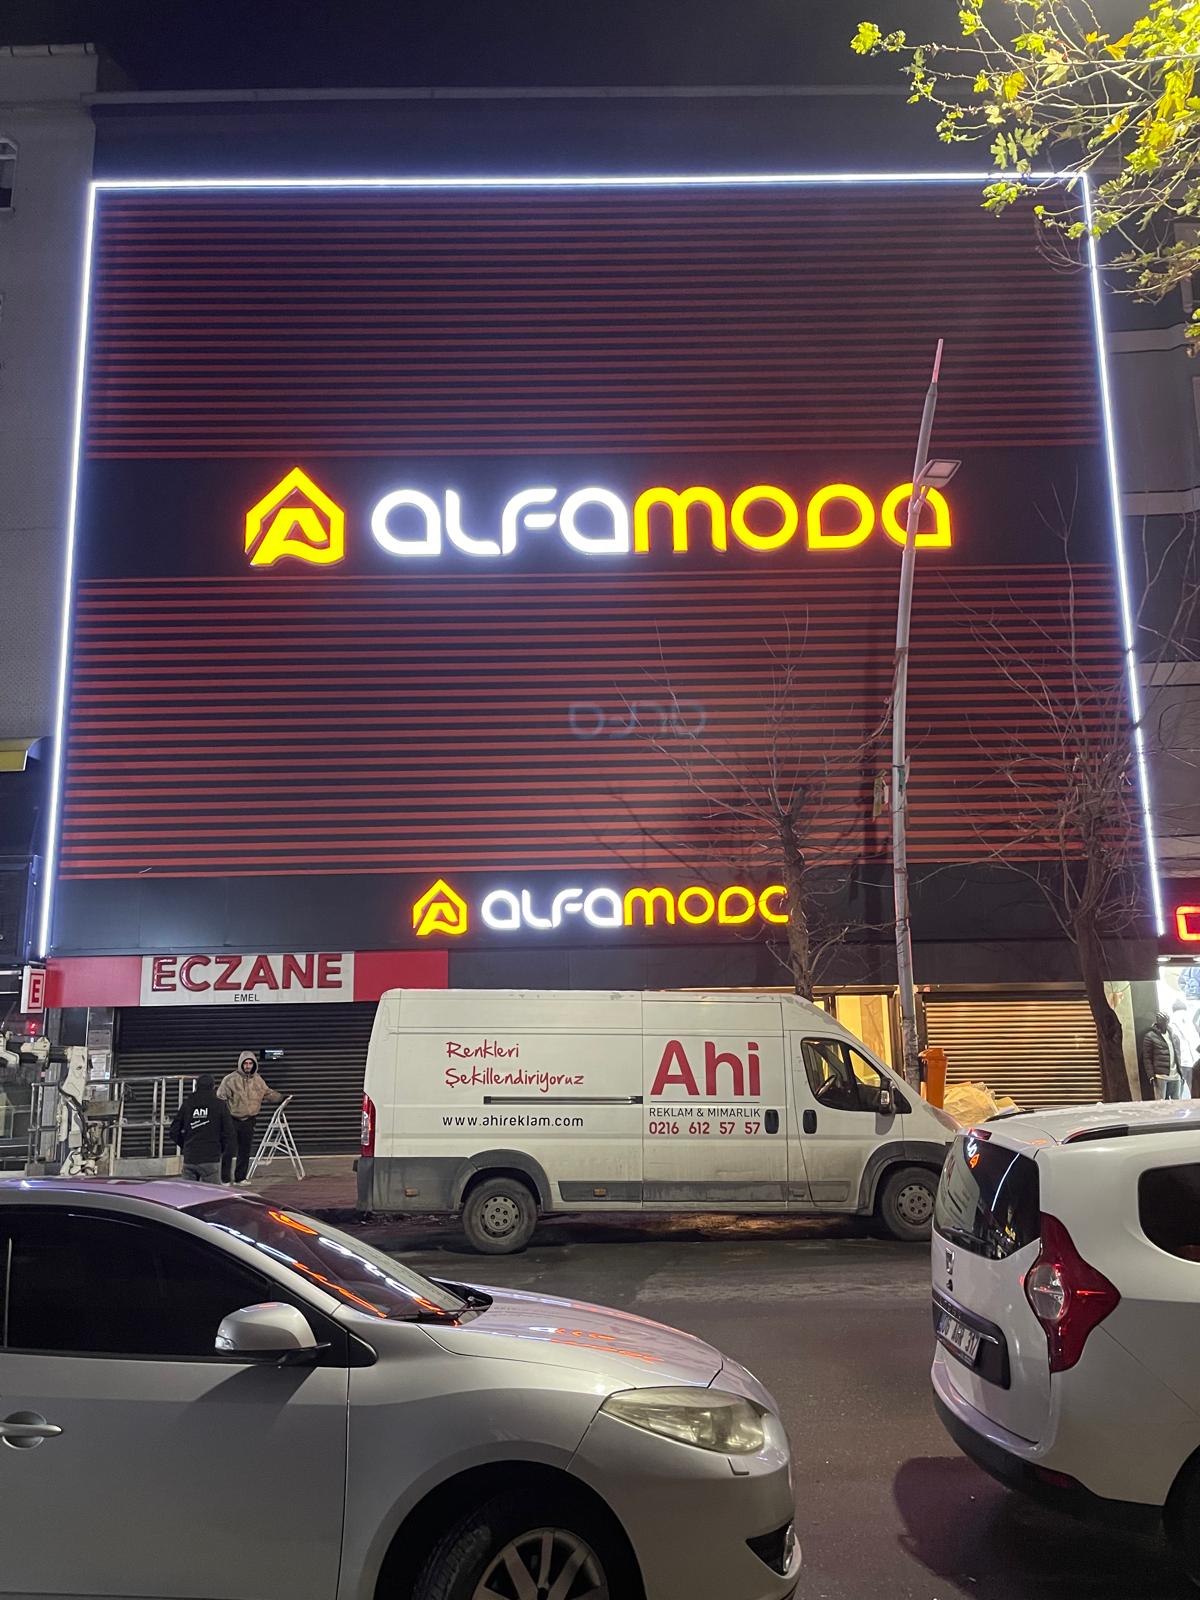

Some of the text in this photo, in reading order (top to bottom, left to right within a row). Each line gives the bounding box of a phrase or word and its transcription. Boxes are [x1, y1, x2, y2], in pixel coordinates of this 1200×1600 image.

[151, 953, 343, 992] ECZANE
[31, 979, 41, 1003] E
[234, 993, 260, 1002] EMEL
[446, 1039, 519, 1058] Renkleri
[650, 1040, 760, 1096] Ahi
[445, 1066, 585, 1092] Şekillendiriyoruz
[442, 1115, 584, 1127] www.ahireklam.com
[649, 1107, 693, 1117] REKLAM
[696, 1108, 704, 1117] &
[649, 1121, 761, 1134] 0216 612 57 57
